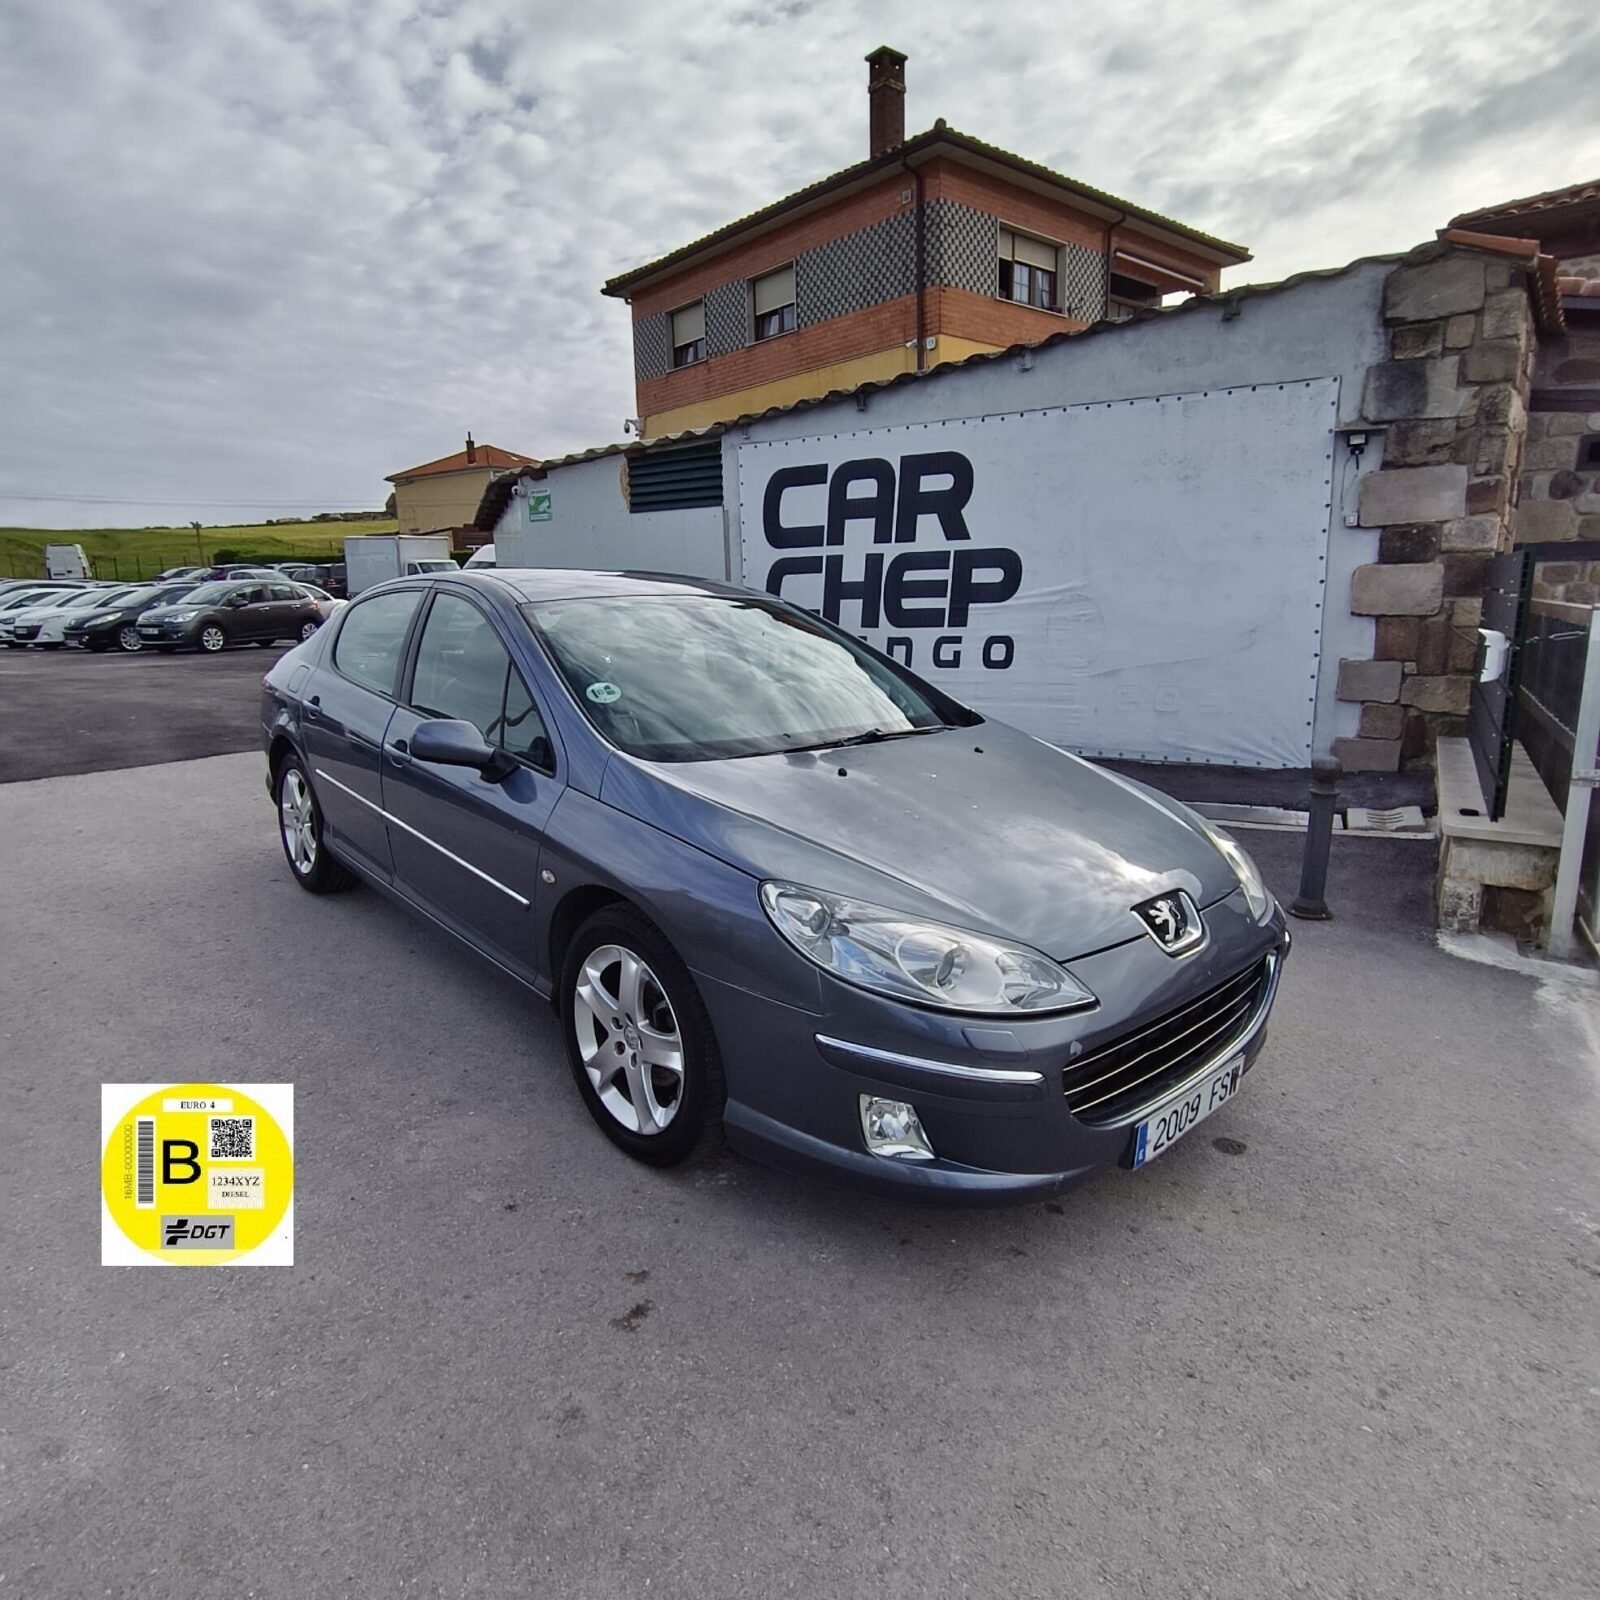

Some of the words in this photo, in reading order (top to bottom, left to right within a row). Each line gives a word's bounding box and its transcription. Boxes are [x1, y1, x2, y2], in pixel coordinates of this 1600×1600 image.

[763, 450, 974, 550] CAR
[766, 547, 1023, 628] CHEP
[857, 635, 1015, 669] NGO
[1153, 1093, 1202, 1152] 2009
[1208, 1064, 1241, 1111] FSW
